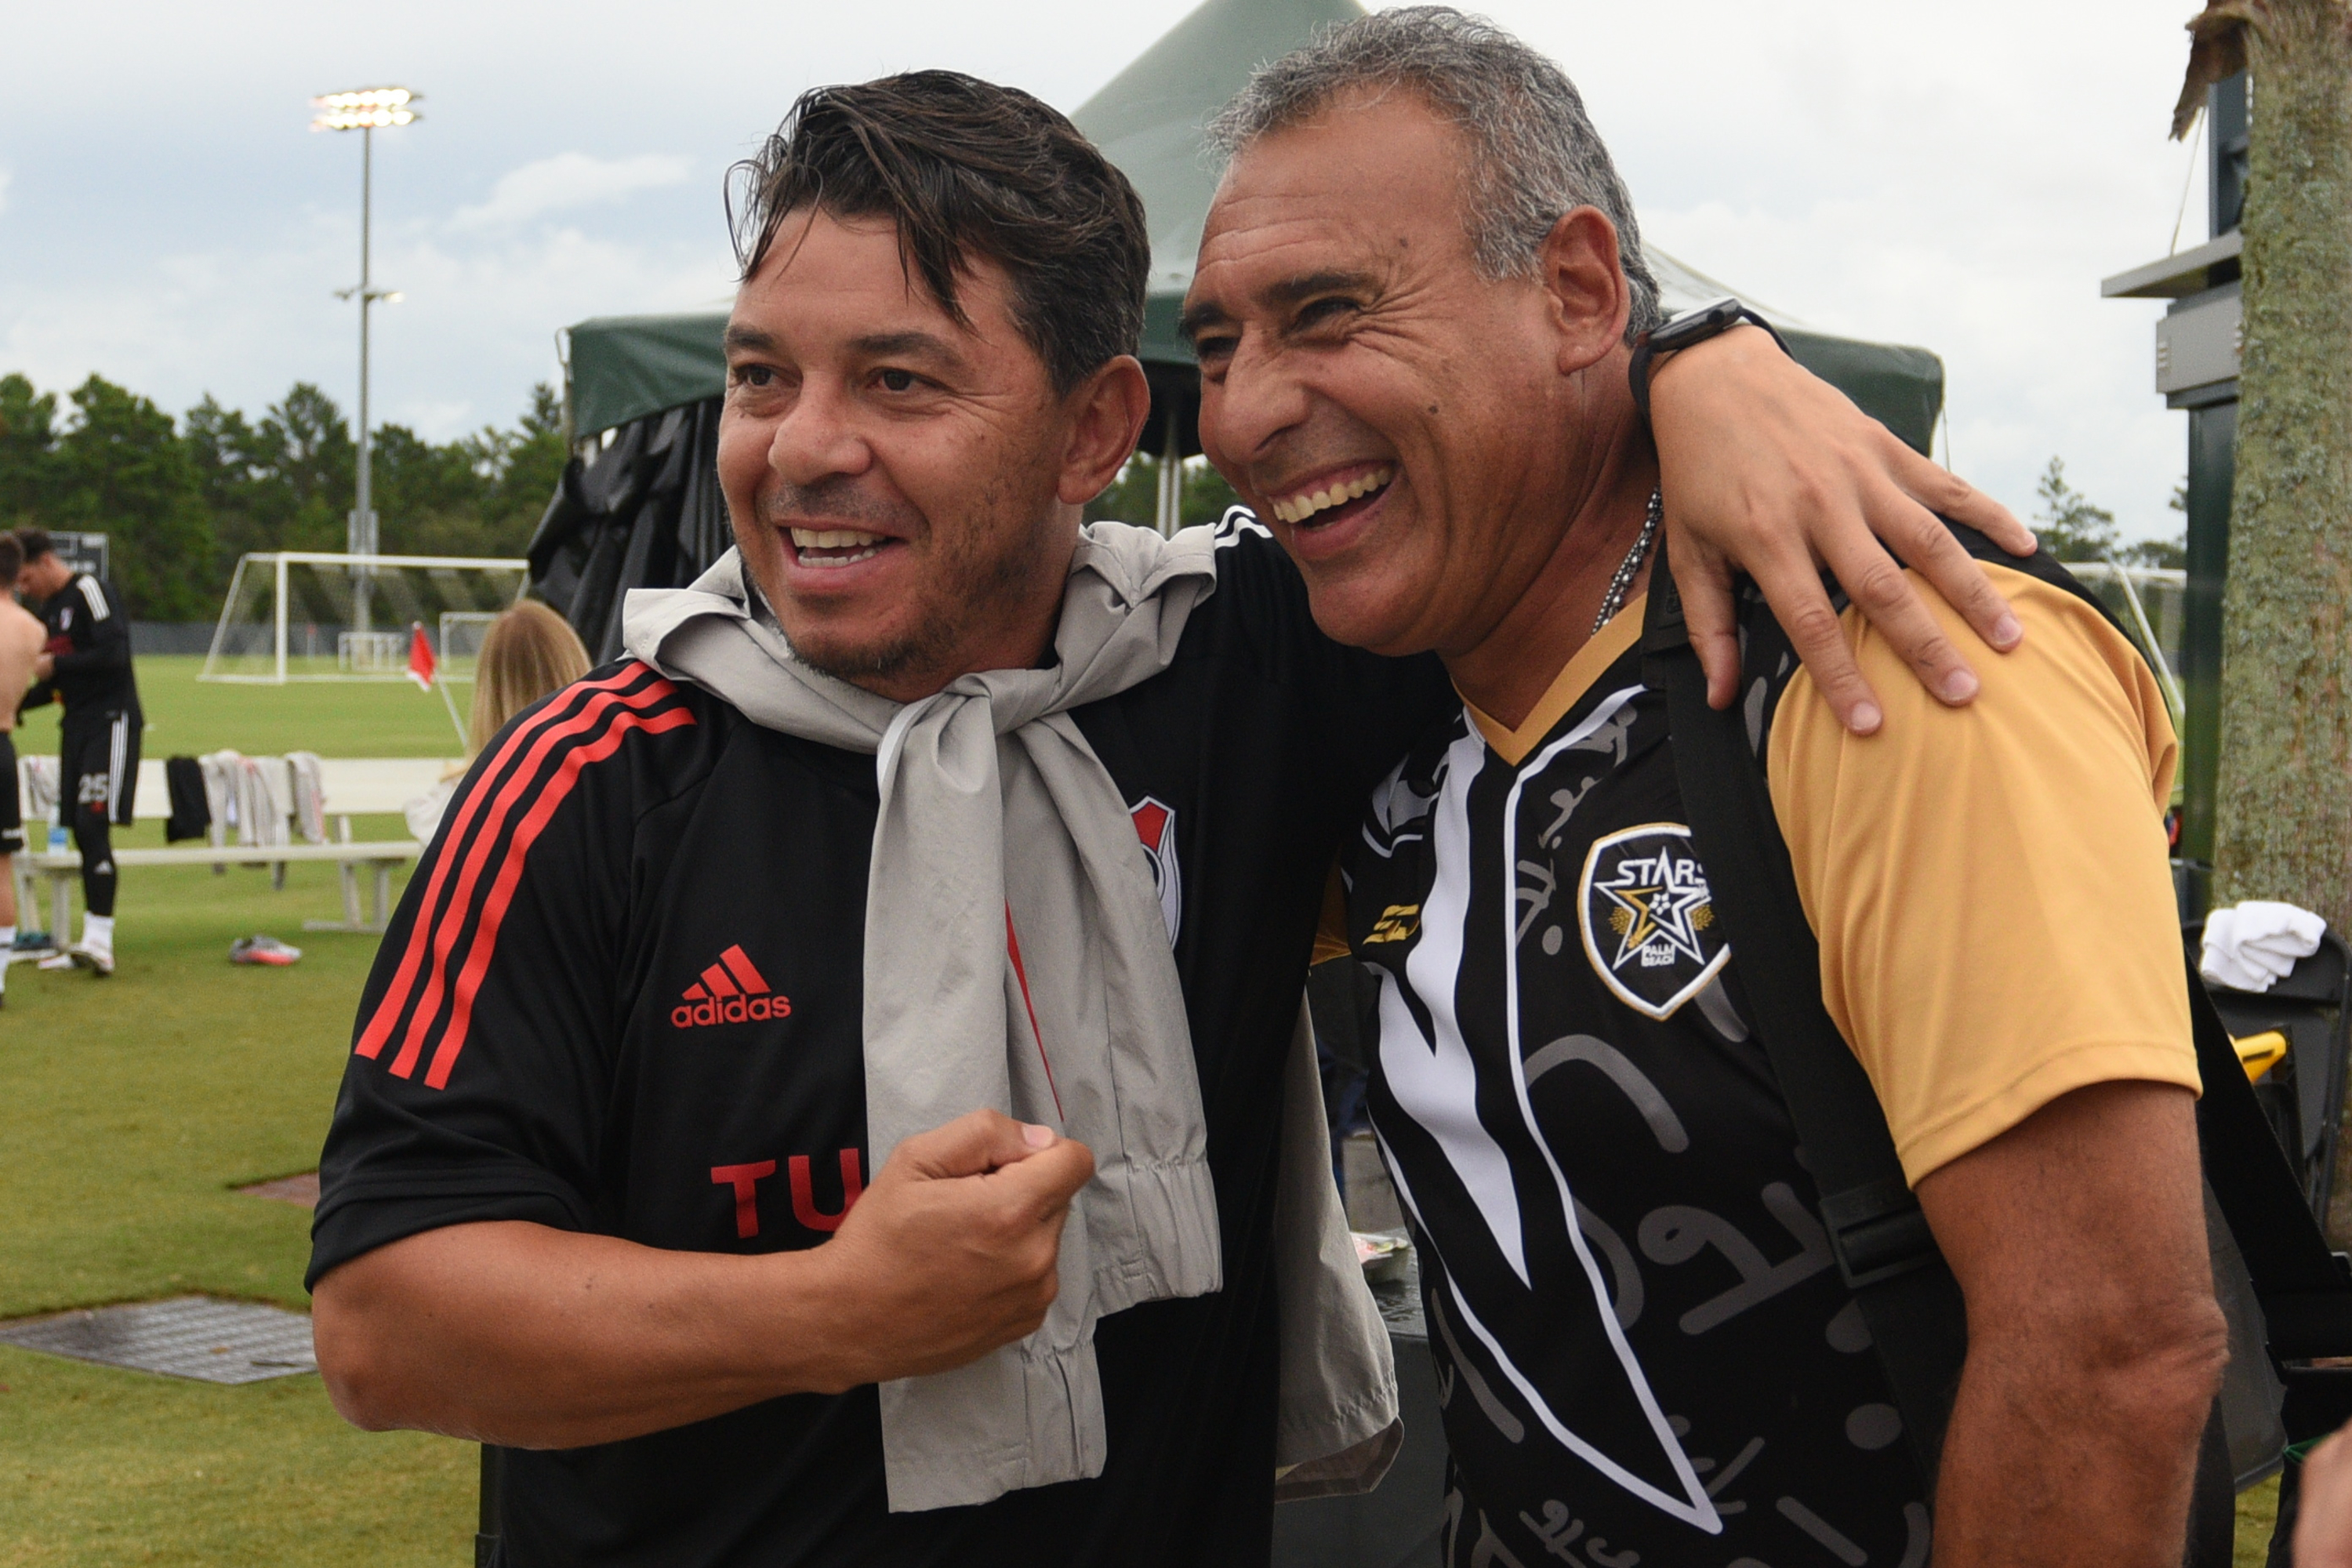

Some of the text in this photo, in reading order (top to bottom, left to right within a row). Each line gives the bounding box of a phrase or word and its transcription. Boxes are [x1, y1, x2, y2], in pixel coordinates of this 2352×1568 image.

[78, 773, 108, 804] 25
[671, 993, 792, 1028] adidas
[711, 1148, 864, 1239] TU
